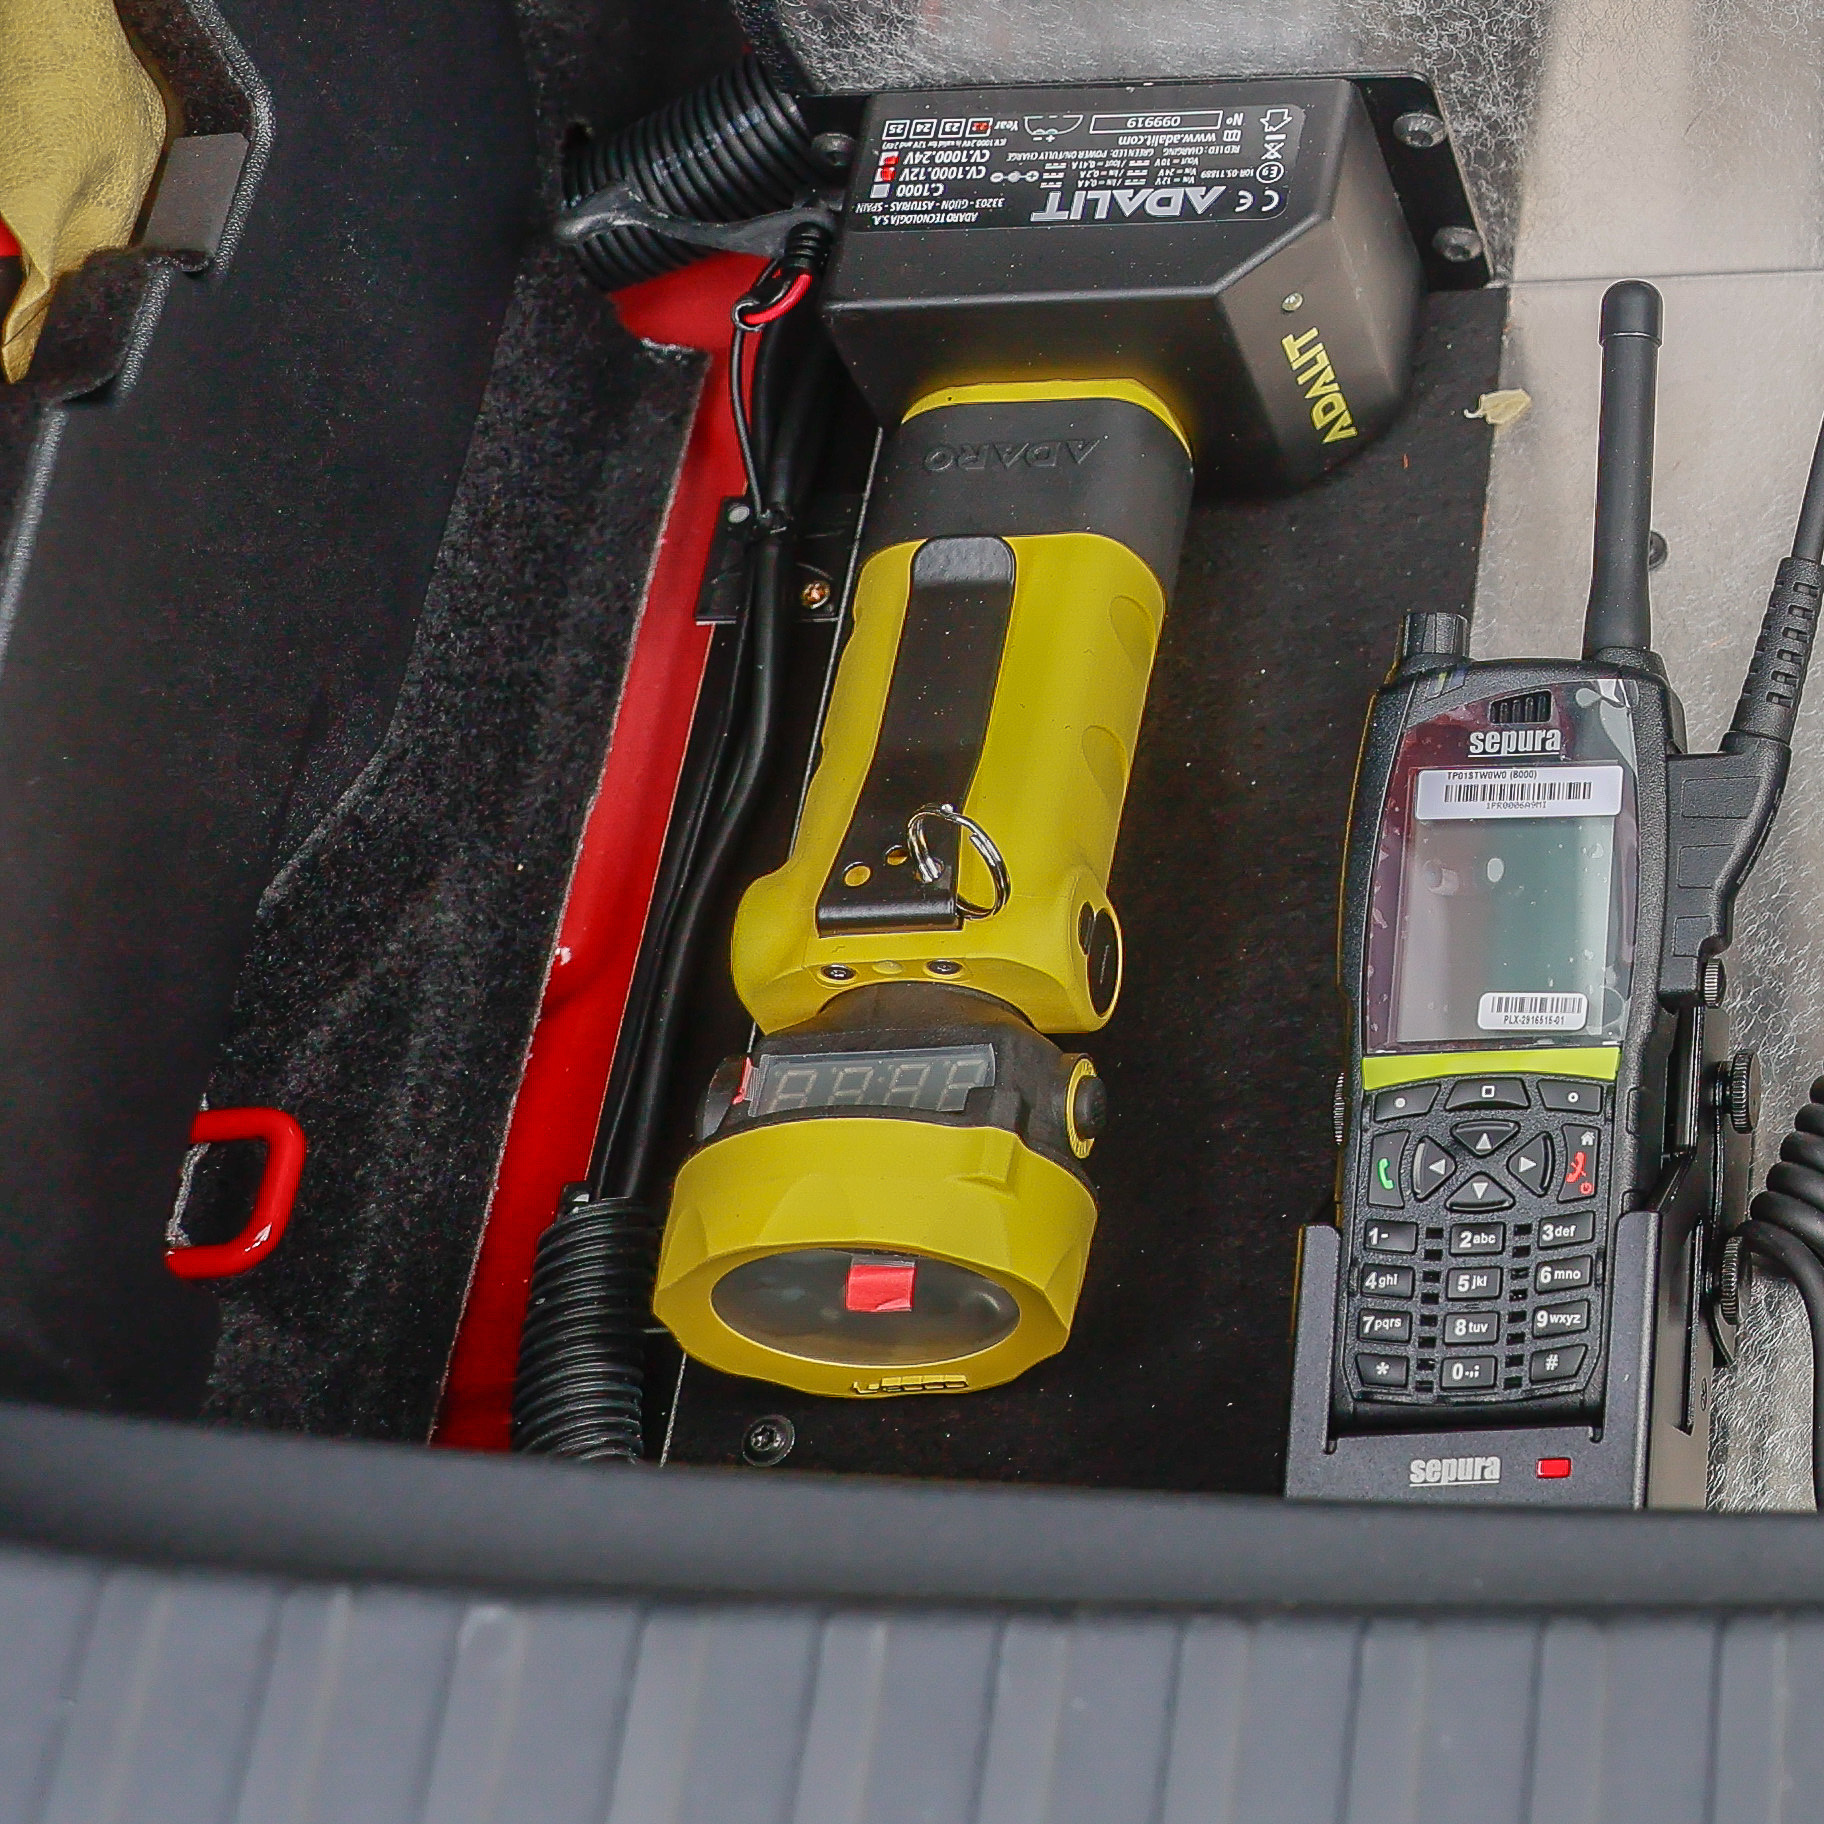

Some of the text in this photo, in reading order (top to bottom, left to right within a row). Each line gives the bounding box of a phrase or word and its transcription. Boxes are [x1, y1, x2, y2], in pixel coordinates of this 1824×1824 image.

[889, 124, 904, 134] 25
[916, 123, 931, 133] 24
[944, 123, 959, 132] 23
[994, 120, 1019, 131] Year
[1126, 116, 1181, 128] 099919
[1118, 132, 1216, 146] www.adalit.com
[903, 149, 990, 165] CV.1000.24V
[899, 166, 986, 182] CV.1000.12V
[896, 183, 945, 197] C.1000
[856, 198, 1005, 213] 33203 ASTURIAS SPAIN
[1031, 186, 1226, 221] ADALIT
[946, 212, 978, 222] ADARO
[1281, 326, 1358, 444] ADALIT
[922, 440, 1101, 472] ADARO
[1468, 728, 1561, 757] sepura
[1503, 1015, 1565, 1025] PLX-2916515-01
[1409, 1456, 1501, 1487] sepura
